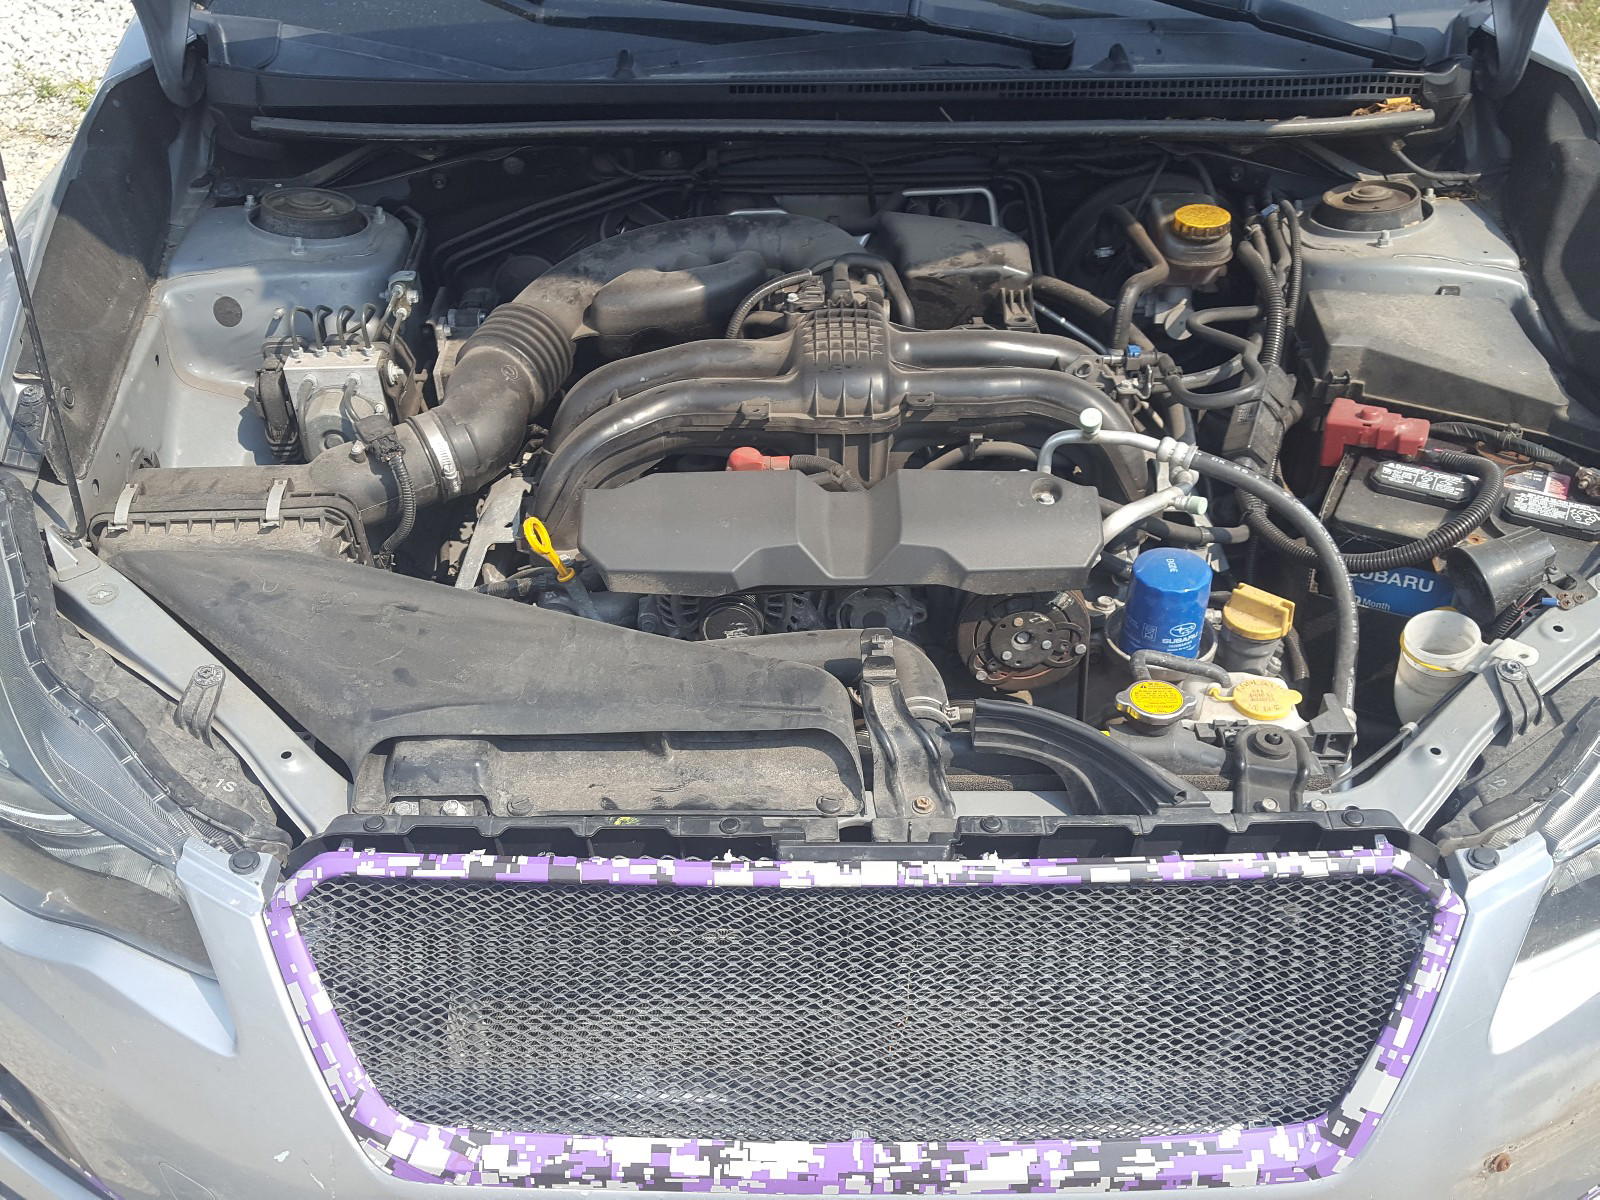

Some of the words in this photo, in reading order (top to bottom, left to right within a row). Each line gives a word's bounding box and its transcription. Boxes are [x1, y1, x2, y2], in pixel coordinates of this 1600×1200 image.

[1348, 570, 1435, 592] UBARU
[1362, 598, 1391, 611] Month
[1161, 631, 1199, 644] SUBARU
[215, 778, 238, 792] 1S
